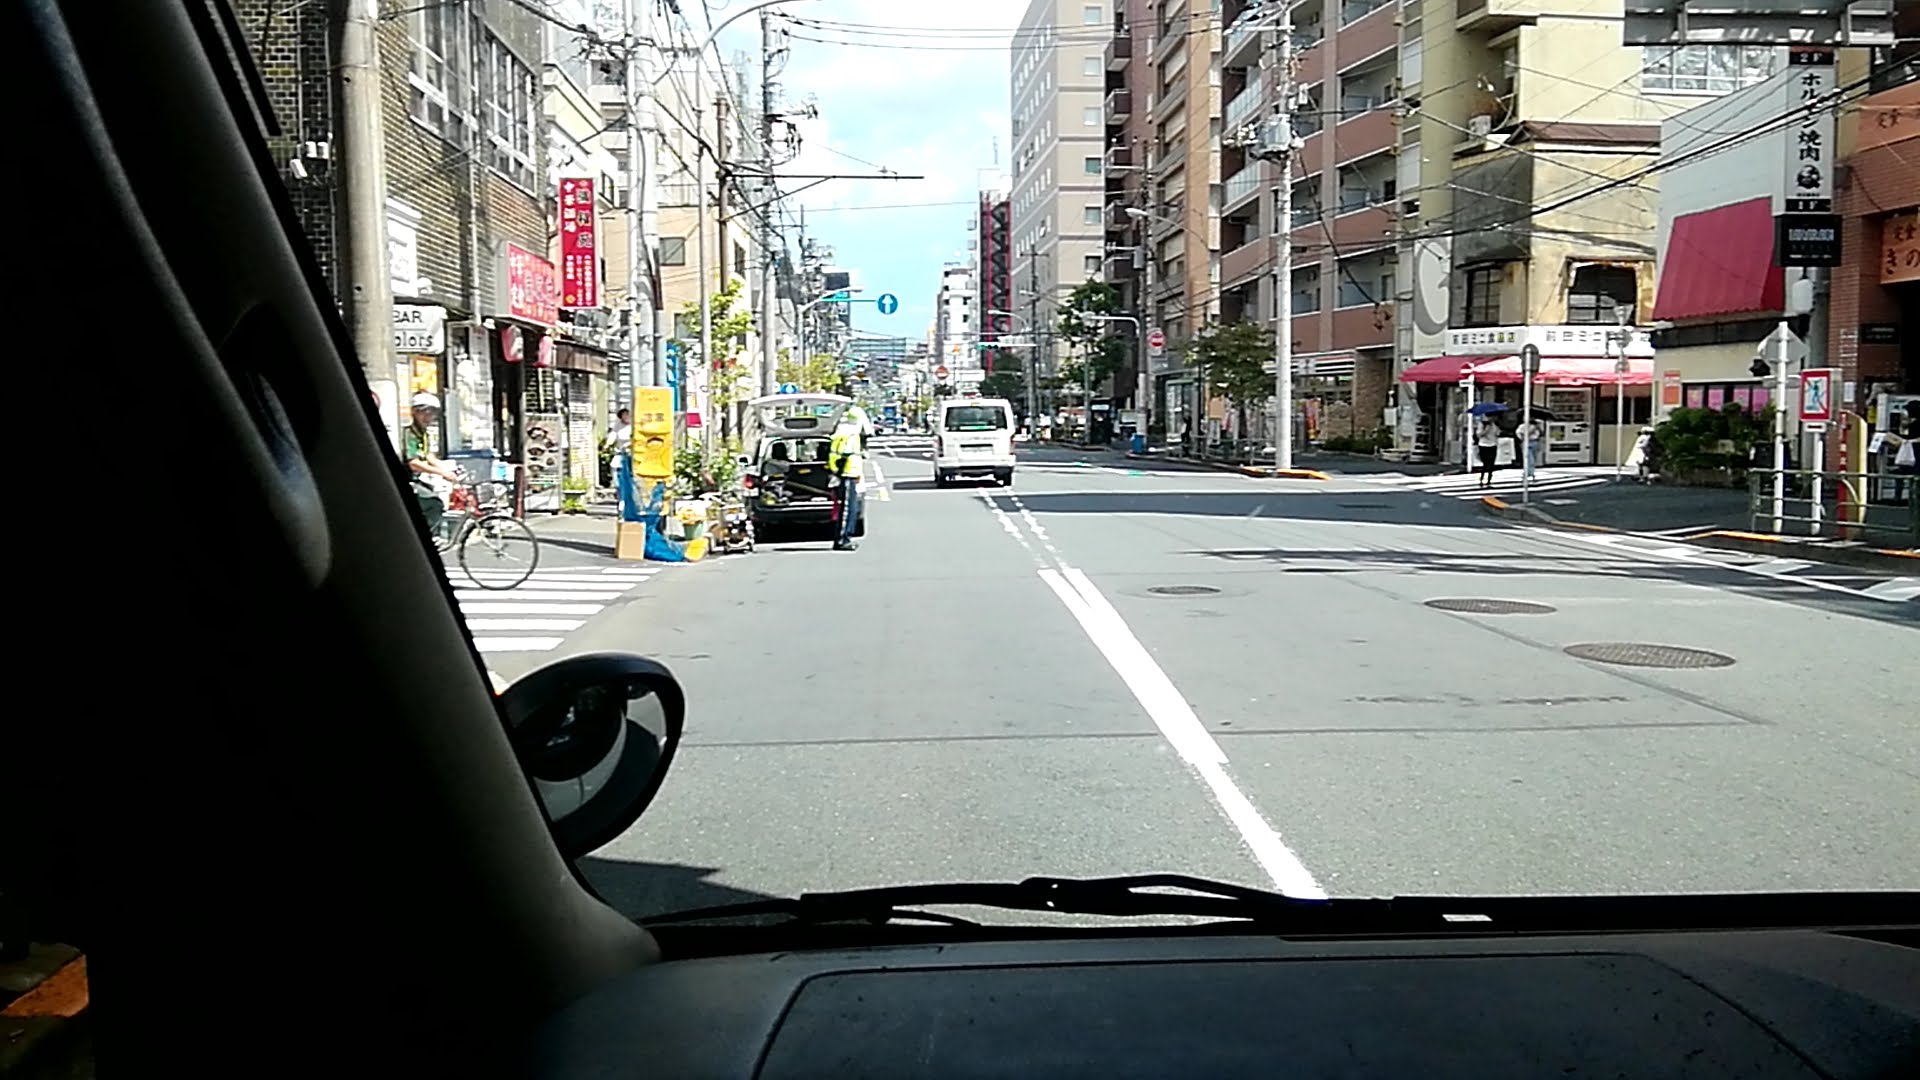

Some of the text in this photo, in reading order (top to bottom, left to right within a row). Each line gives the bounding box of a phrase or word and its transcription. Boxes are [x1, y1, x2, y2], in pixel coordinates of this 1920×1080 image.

[1797, 73, 1823, 162] ホルン焼肉
[392, 310, 423, 323] BAR
[394, 331, 433, 347] olors
